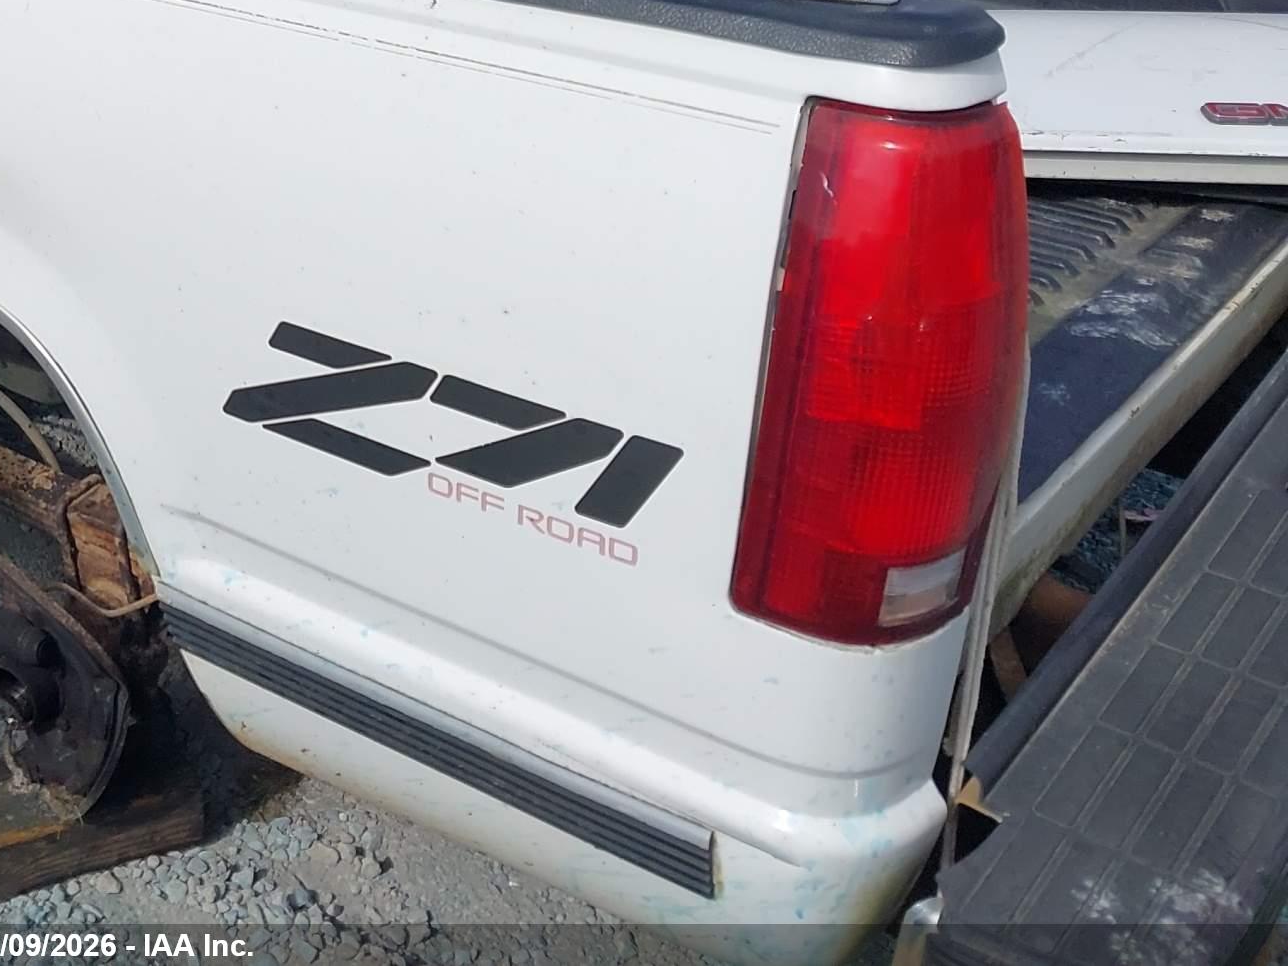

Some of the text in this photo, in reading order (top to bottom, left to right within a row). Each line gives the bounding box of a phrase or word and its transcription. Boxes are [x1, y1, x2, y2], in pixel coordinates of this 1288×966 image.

[222, 321, 684, 528] Z71
[428, 472, 638, 566] OFF ROAD
